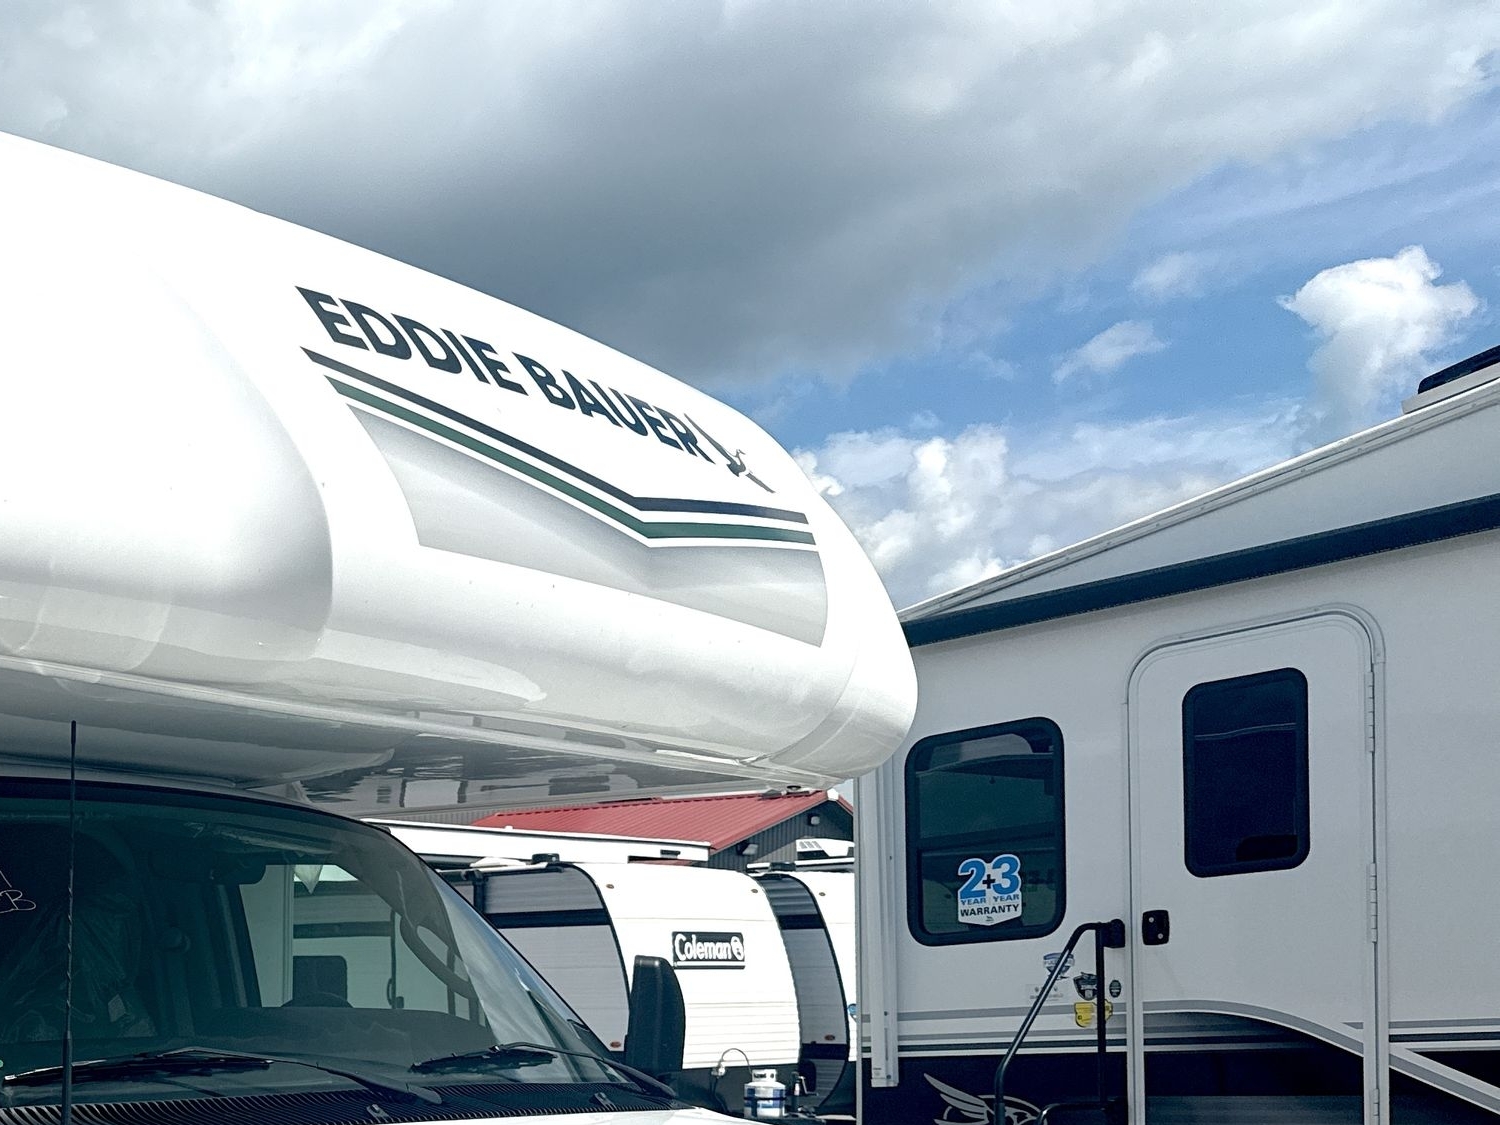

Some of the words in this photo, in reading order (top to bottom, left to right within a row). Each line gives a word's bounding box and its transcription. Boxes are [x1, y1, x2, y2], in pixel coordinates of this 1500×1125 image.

[294, 285, 529, 396] EDDIE
[512, 351, 716, 465] BAUER
[960, 897, 987, 905] YEAR
[993, 894, 1020, 902] YEAR
[960, 903, 1020, 917] WARRANTY
[674, 933, 732, 961] Coleman
